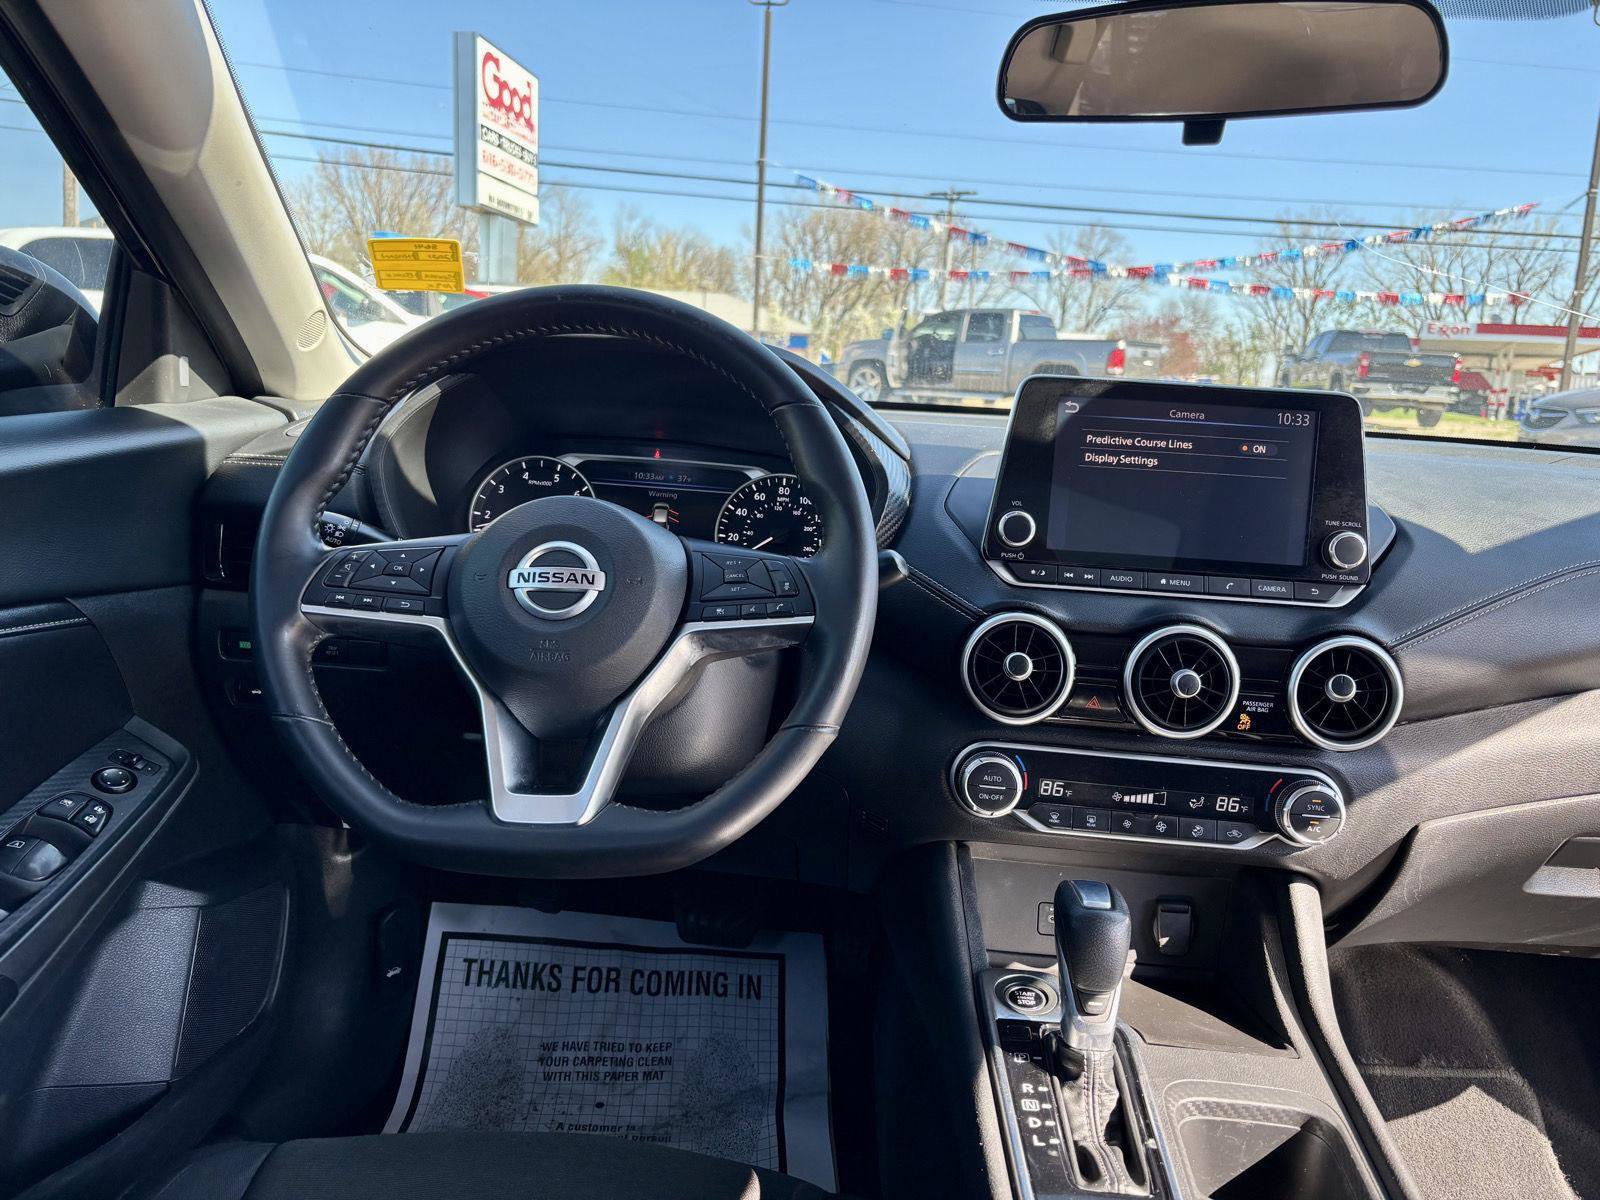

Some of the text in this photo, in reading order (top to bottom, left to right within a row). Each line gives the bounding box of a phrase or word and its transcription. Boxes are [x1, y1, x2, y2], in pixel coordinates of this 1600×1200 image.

[482, 52, 534, 132] Good
[1427, 322, 1470, 338] Exxon
[1169, 410, 1205, 420] Camera
[1276, 412, 1310, 426] 10:33
[1086, 435, 1193, 450] Predictive Course Lines
[1253, 445, 1266, 454] ON
[1085, 453, 1158, 467] Display Settings
[554, 474, 560, 482] 5
[498, 485, 504, 493] 3
[778, 487, 790, 495] 80
[649, 491, 678, 499] Warning
[484, 511, 491, 519] 2
[735, 508, 747, 516] 40
[325, 536, 342, 545] AUTO
[727, 533, 739, 541] 20
[517, 571, 596, 586] NISSAN
[1109, 575, 1133, 583] AUDIO
[1169, 579, 1191, 587] MENU
[1257, 585, 1287, 593] CAMERA
[1237, 723, 1251, 731] OFF
[983, 775, 1002, 783] AUTO
[1307, 804, 1325, 812] SYNC
[1306, 825, 1321, 833] A/C
[463, 957, 762, 1000] THANKS FOR COMING IN
[542, 1040, 673, 1053] WE HAVE TRIED TO KEEP
[540, 1055, 672, 1067] YOUR CARPETING CLEAN
[543, 1070, 666, 1081] WITH THIS PAPER MAT
[1022, 1083, 1034, 1093] R
[1028, 1116, 1042, 1128] D
[555, 1121, 565, 1131] A
[567, 1123, 622, 1133] customer
[1032, 1134, 1046, 1146] L
